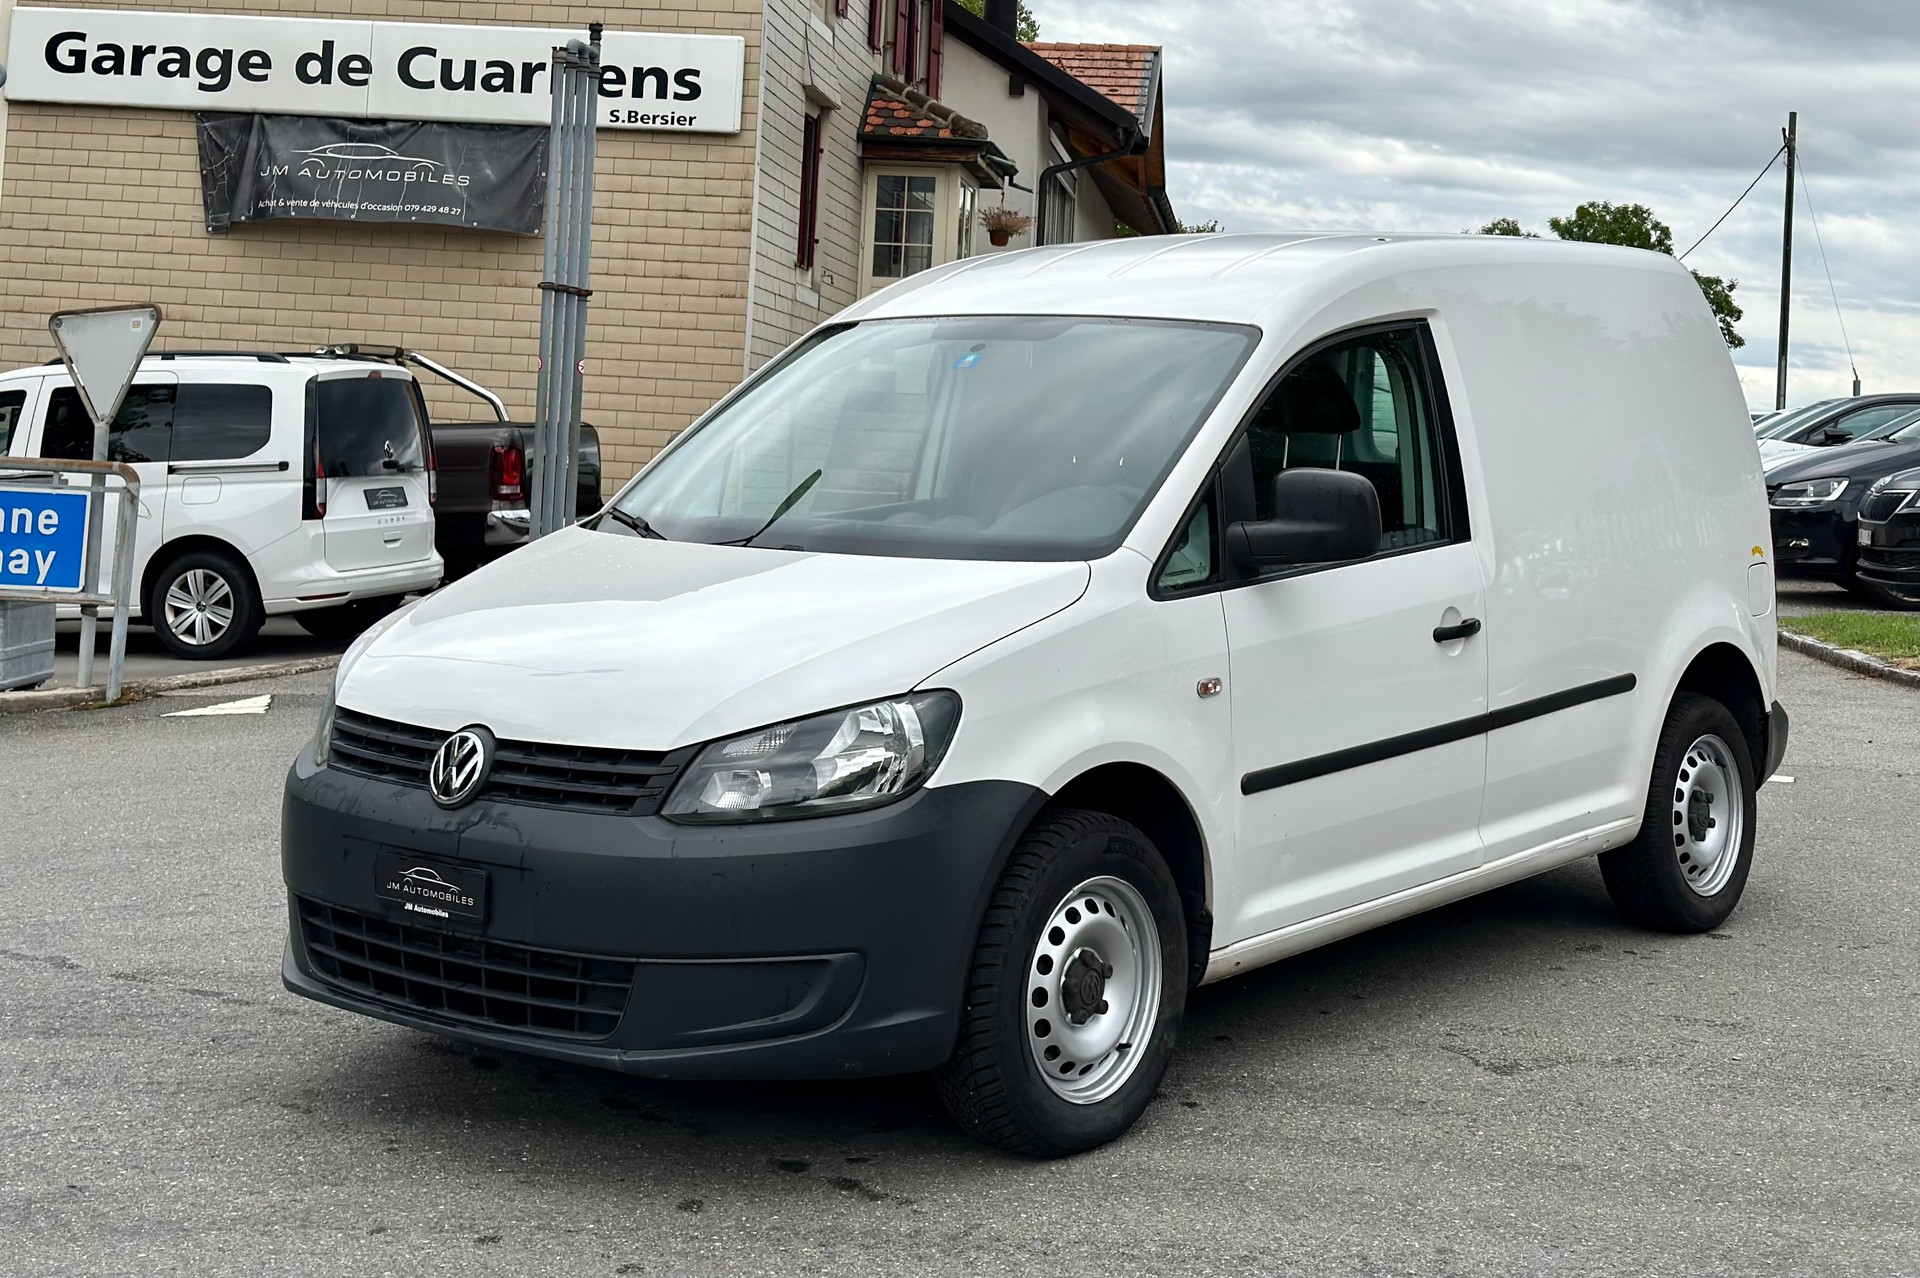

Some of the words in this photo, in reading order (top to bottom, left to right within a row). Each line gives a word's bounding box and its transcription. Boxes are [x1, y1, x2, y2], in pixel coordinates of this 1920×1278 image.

[44, 31, 273, 92] Garage
[295, 40, 373, 87] de
[397, 46, 702, 102] Cuarens
[609, 109, 697, 127] S.Bersier
[260, 165, 289, 177] JM
[298, 166, 471, 187] AUTOMOBILES
[257, 198, 277, 209] Achat
[278, 198, 285, 208] &
[286, 199, 309, 208] vente
[309, 198, 320, 208] de
[321, 199, 359, 210] véhicules
[360, 201, 403, 212] d'occasion
[404, 204, 420, 212] 079
[420, 204, 437, 213] 429
[438, 206, 450, 214] 48
[450, 207, 462, 216] 27
[386, 881, 400, 891] JM
[403, 884, 474, 906] AUTOMOBILES
[404, 902, 413, 911] JM
[413, 904, 449, 919] Automobiles
